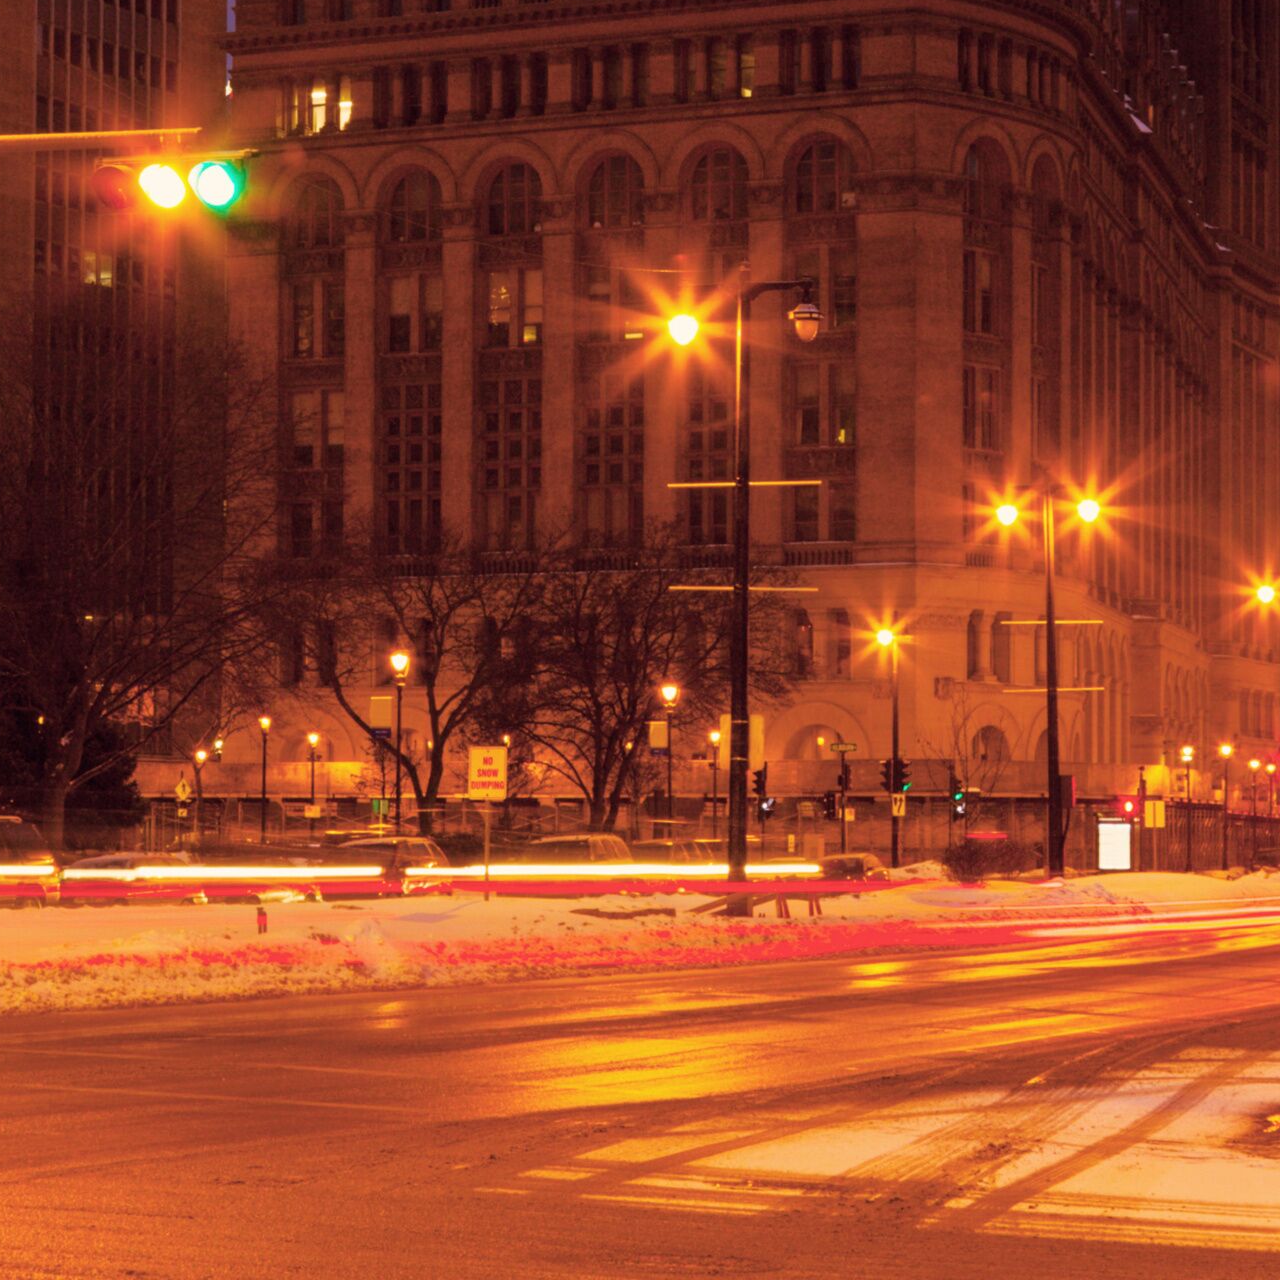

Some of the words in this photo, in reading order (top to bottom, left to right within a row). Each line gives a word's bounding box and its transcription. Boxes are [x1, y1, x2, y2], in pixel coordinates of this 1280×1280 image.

[483, 756, 493, 765] NO
[477, 768, 498, 777] SNOW
[471, 781, 504, 789] DUMPING
